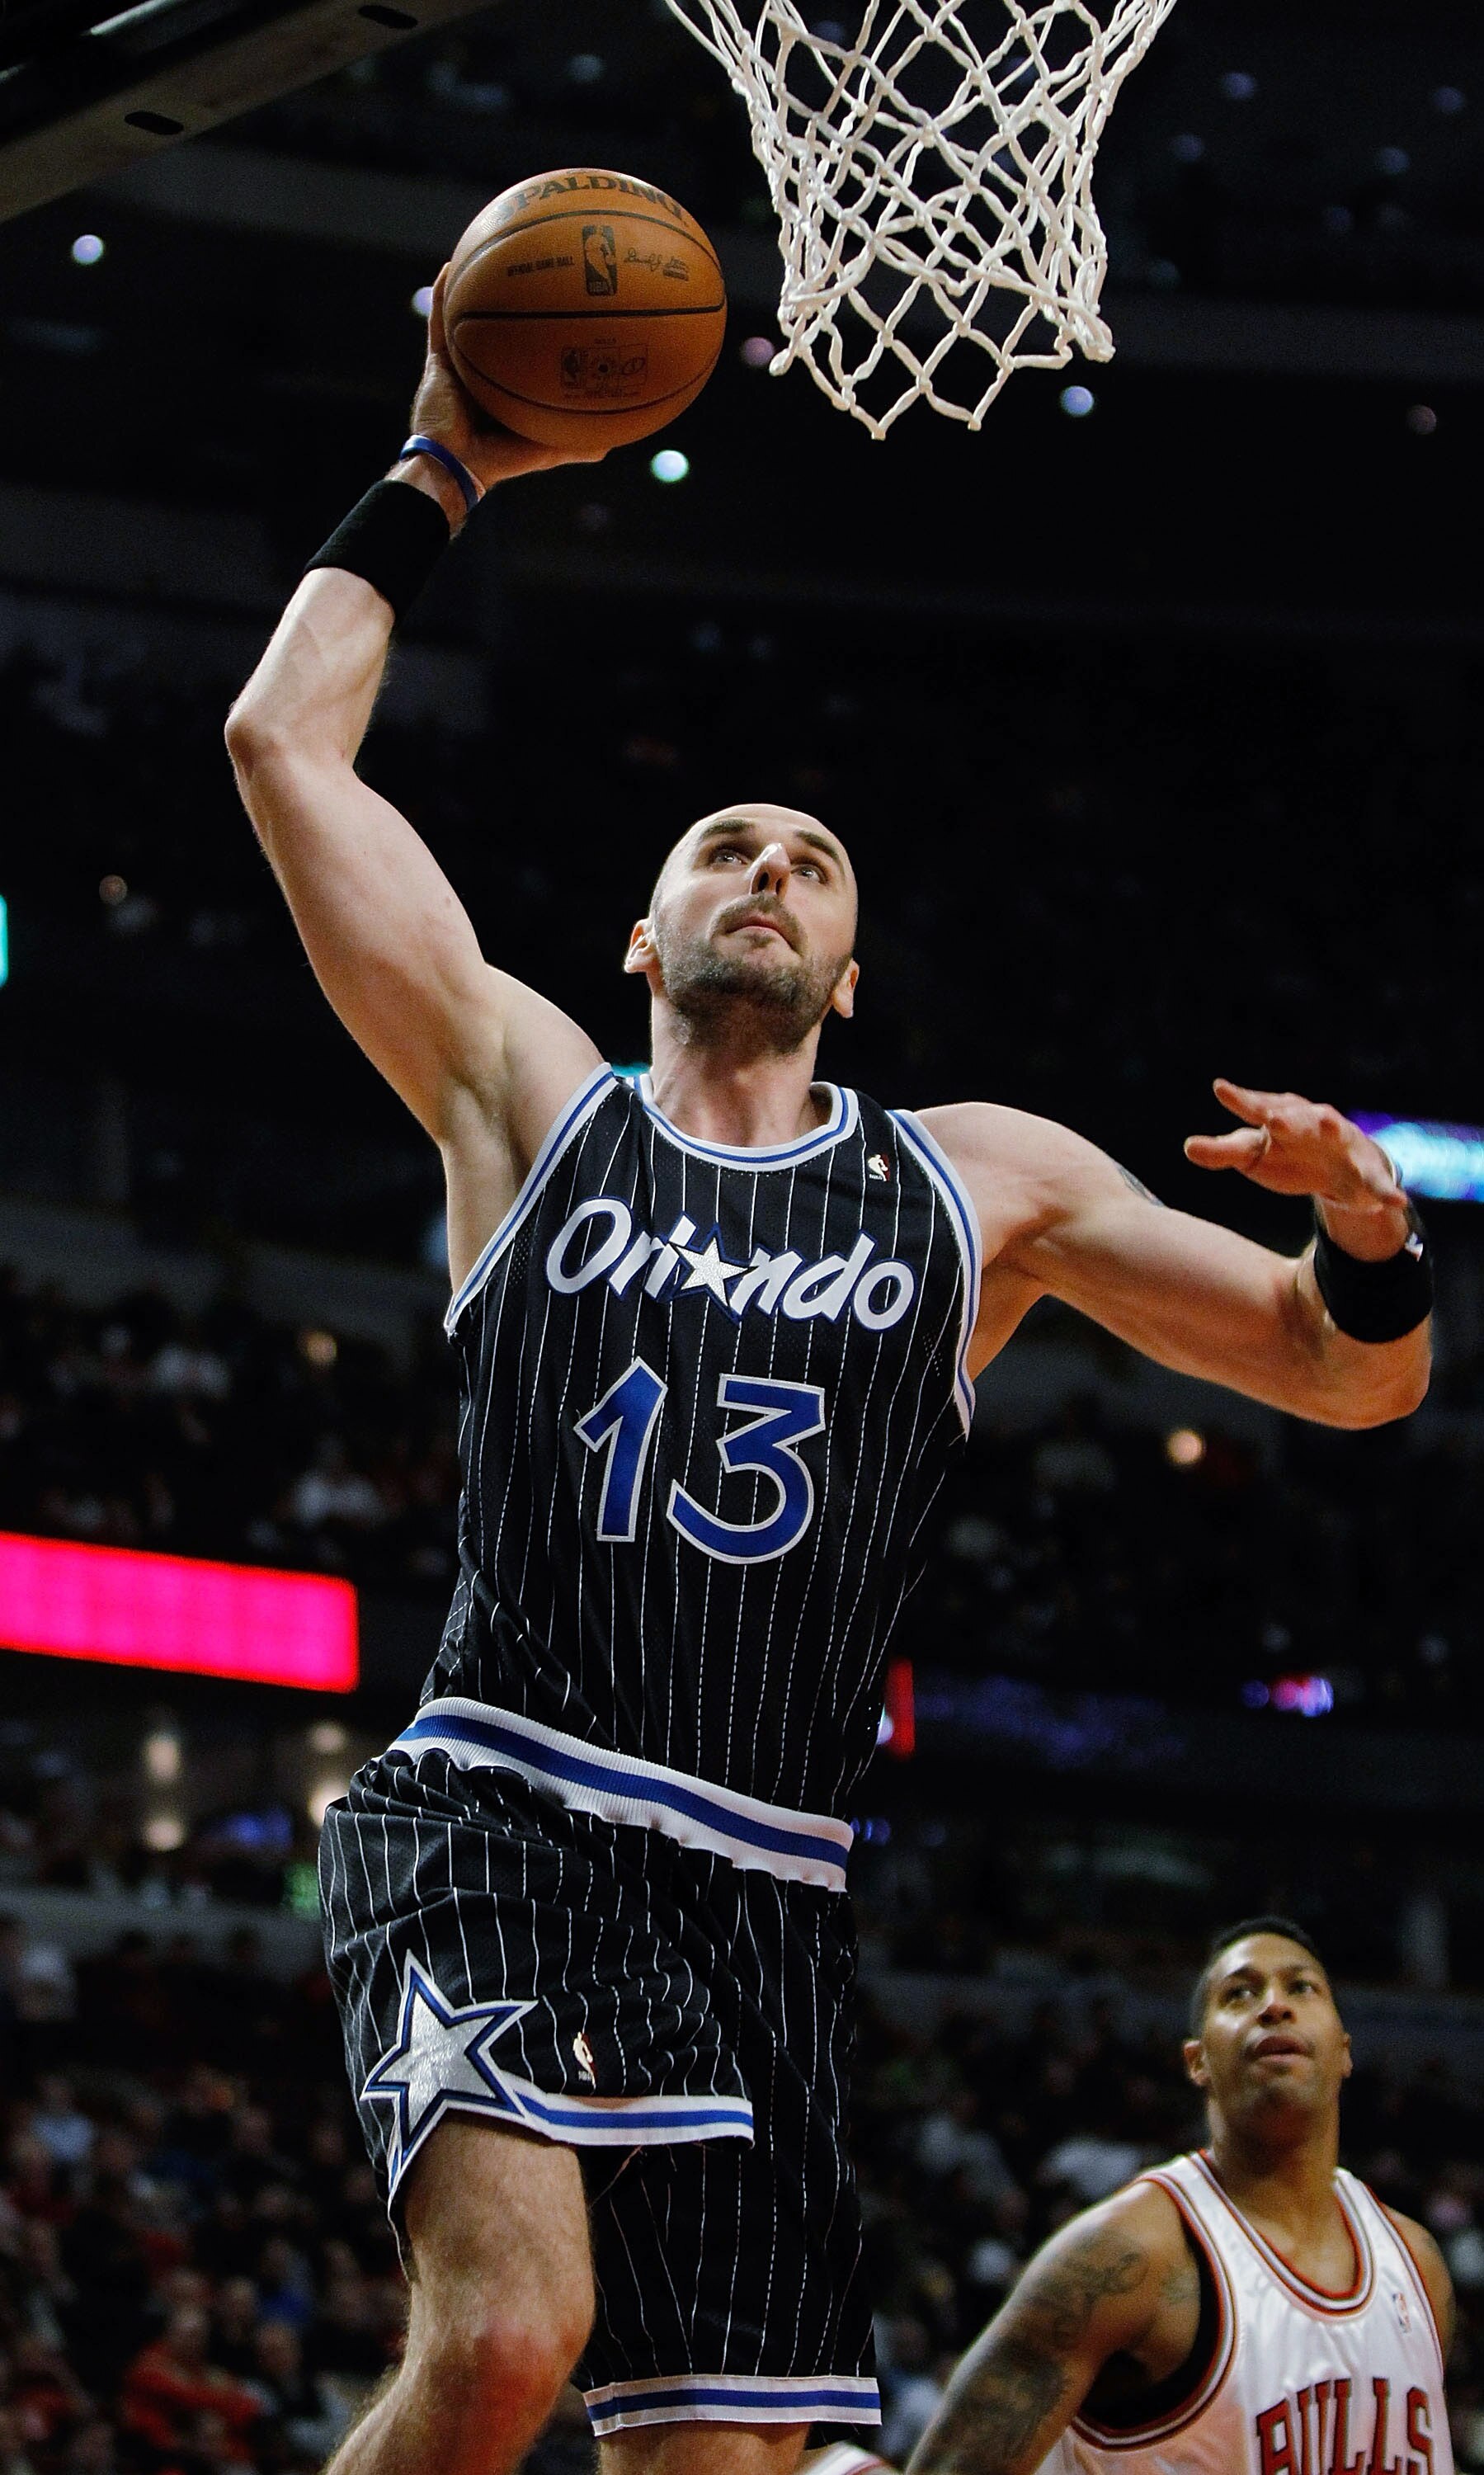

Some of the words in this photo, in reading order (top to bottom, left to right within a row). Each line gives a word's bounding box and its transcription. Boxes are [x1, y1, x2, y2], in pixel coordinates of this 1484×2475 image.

[557, 256, 575, 266] BALL
[545, 1196, 915, 1330] Orlndo
[574, 1356, 826, 1564] 13
[1256, 2377, 1433, 2475] BULLS
